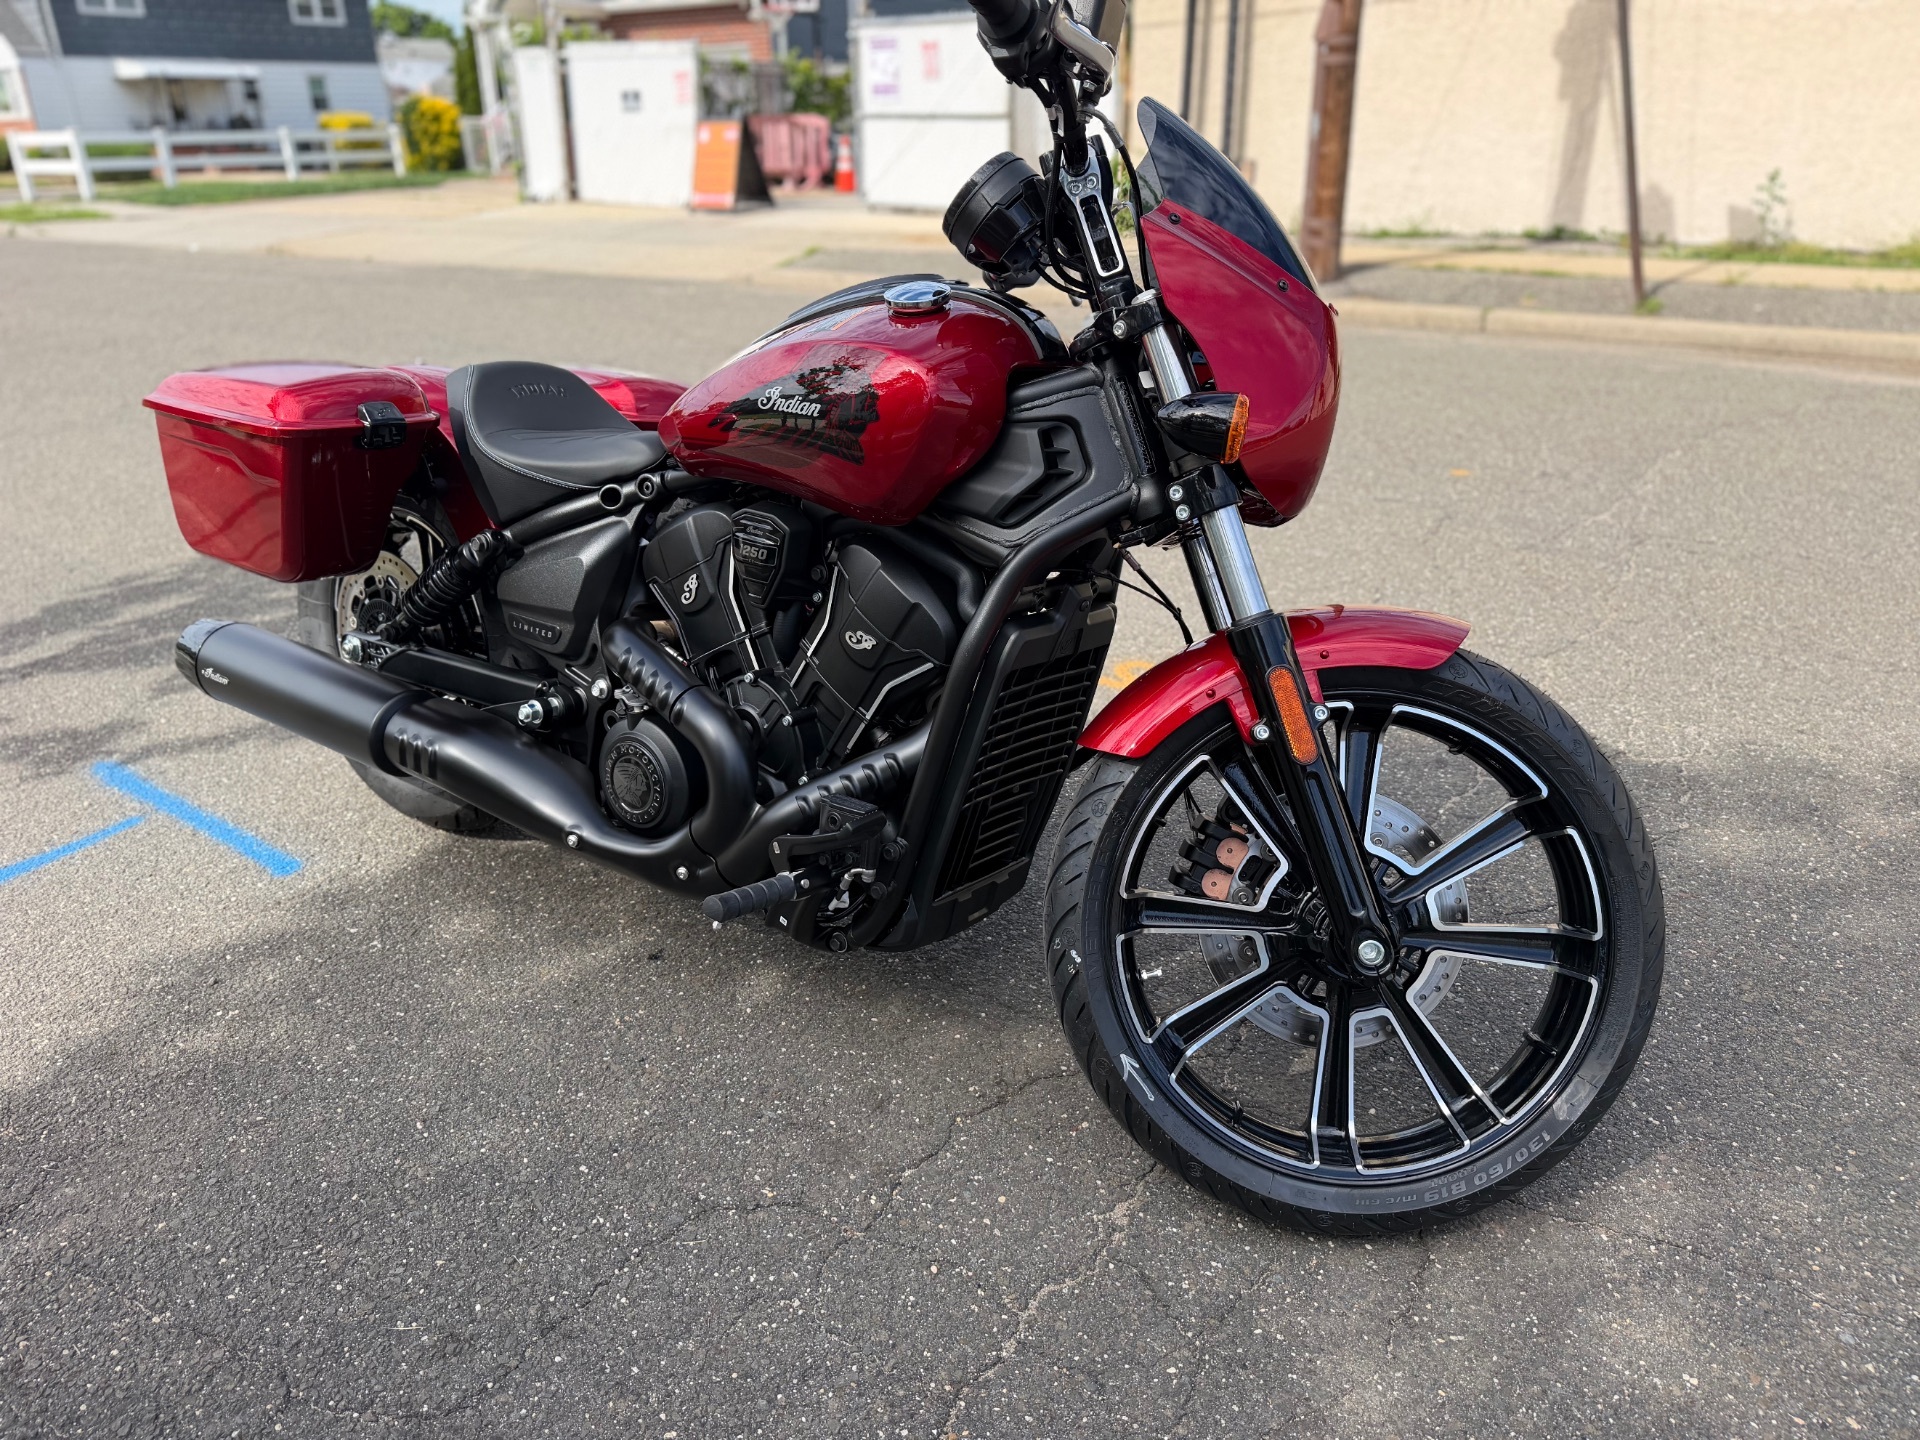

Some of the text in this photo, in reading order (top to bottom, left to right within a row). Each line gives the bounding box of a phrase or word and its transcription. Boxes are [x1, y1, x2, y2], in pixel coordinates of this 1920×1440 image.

[757, 386, 822, 418] Indian
[739, 543, 768, 561] 1250
[513, 620, 552, 639] LIMITED
[620, 744, 661, 816] MOTORCYCLE
[1472, 1129, 1551, 1187] 130/60
[1423, 1180, 1468, 1203] B19
